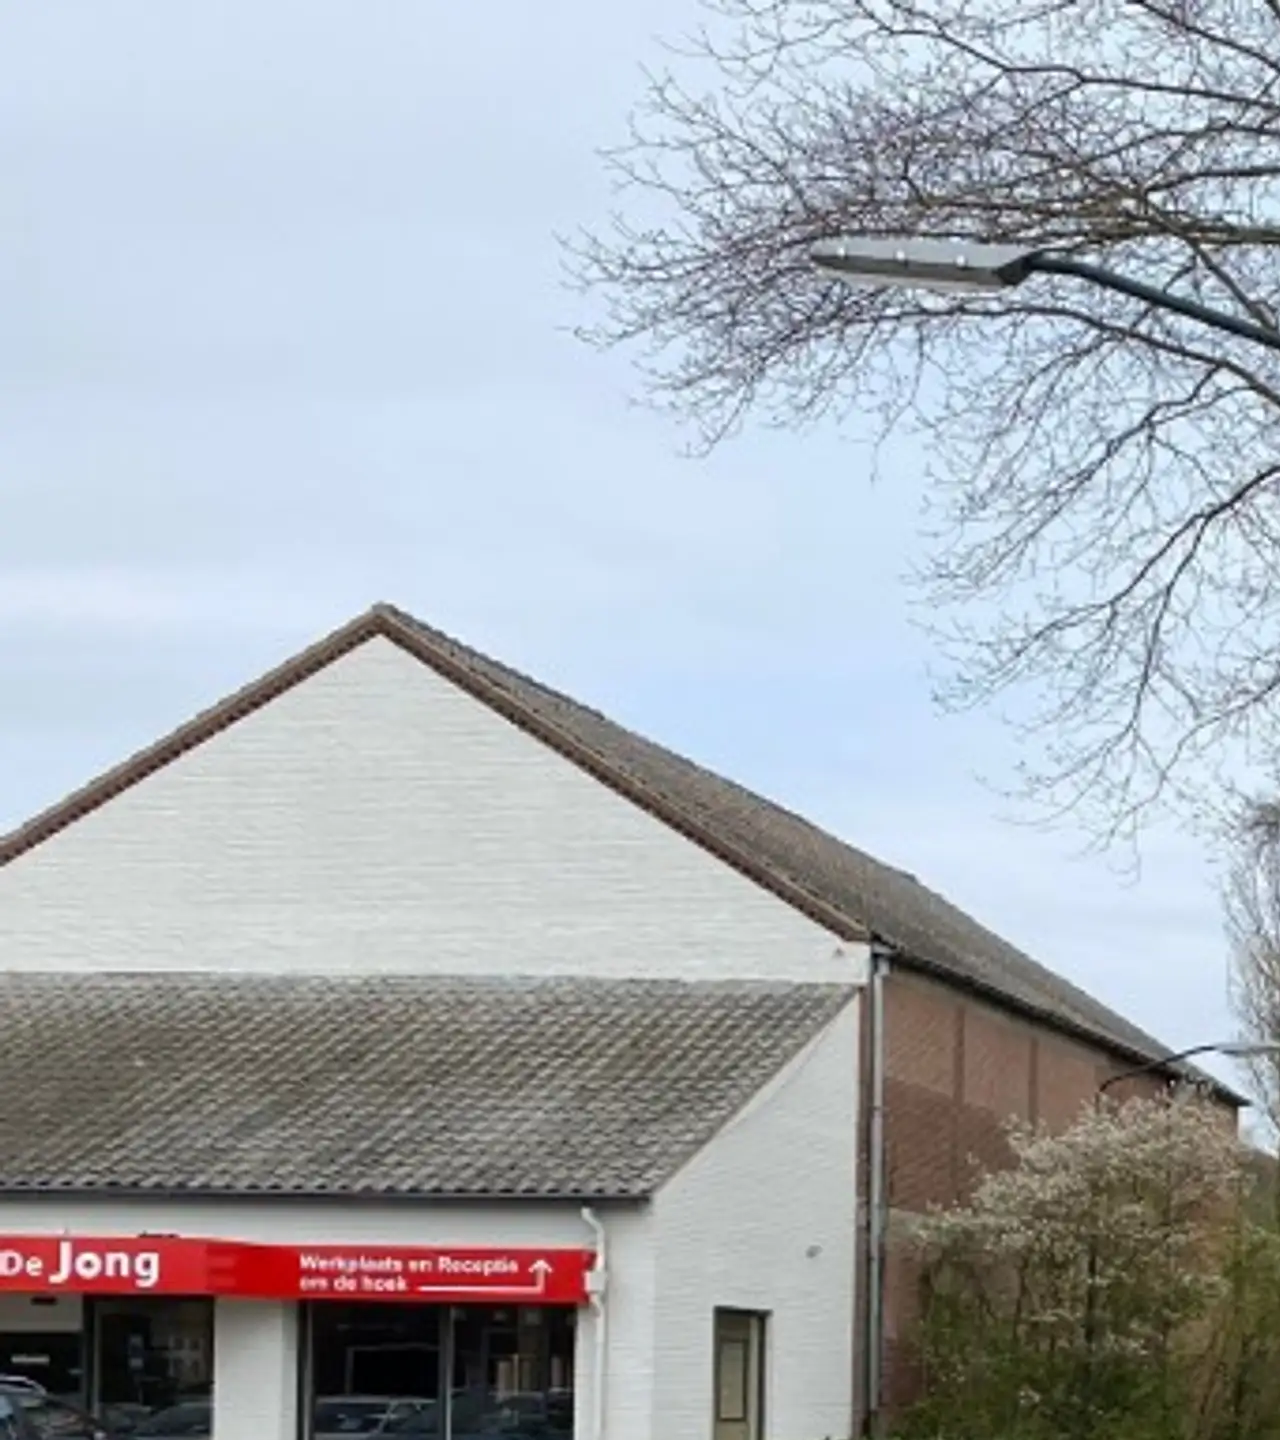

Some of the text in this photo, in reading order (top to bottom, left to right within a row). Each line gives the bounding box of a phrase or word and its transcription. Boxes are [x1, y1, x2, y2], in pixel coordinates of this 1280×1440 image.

[0, 1240, 160, 1288] De Jong
[299, 1253, 519, 1276] Werkplaats en Receptie
[333, 1275, 357, 1292] de
[360, 1275, 408, 1292] hoek
